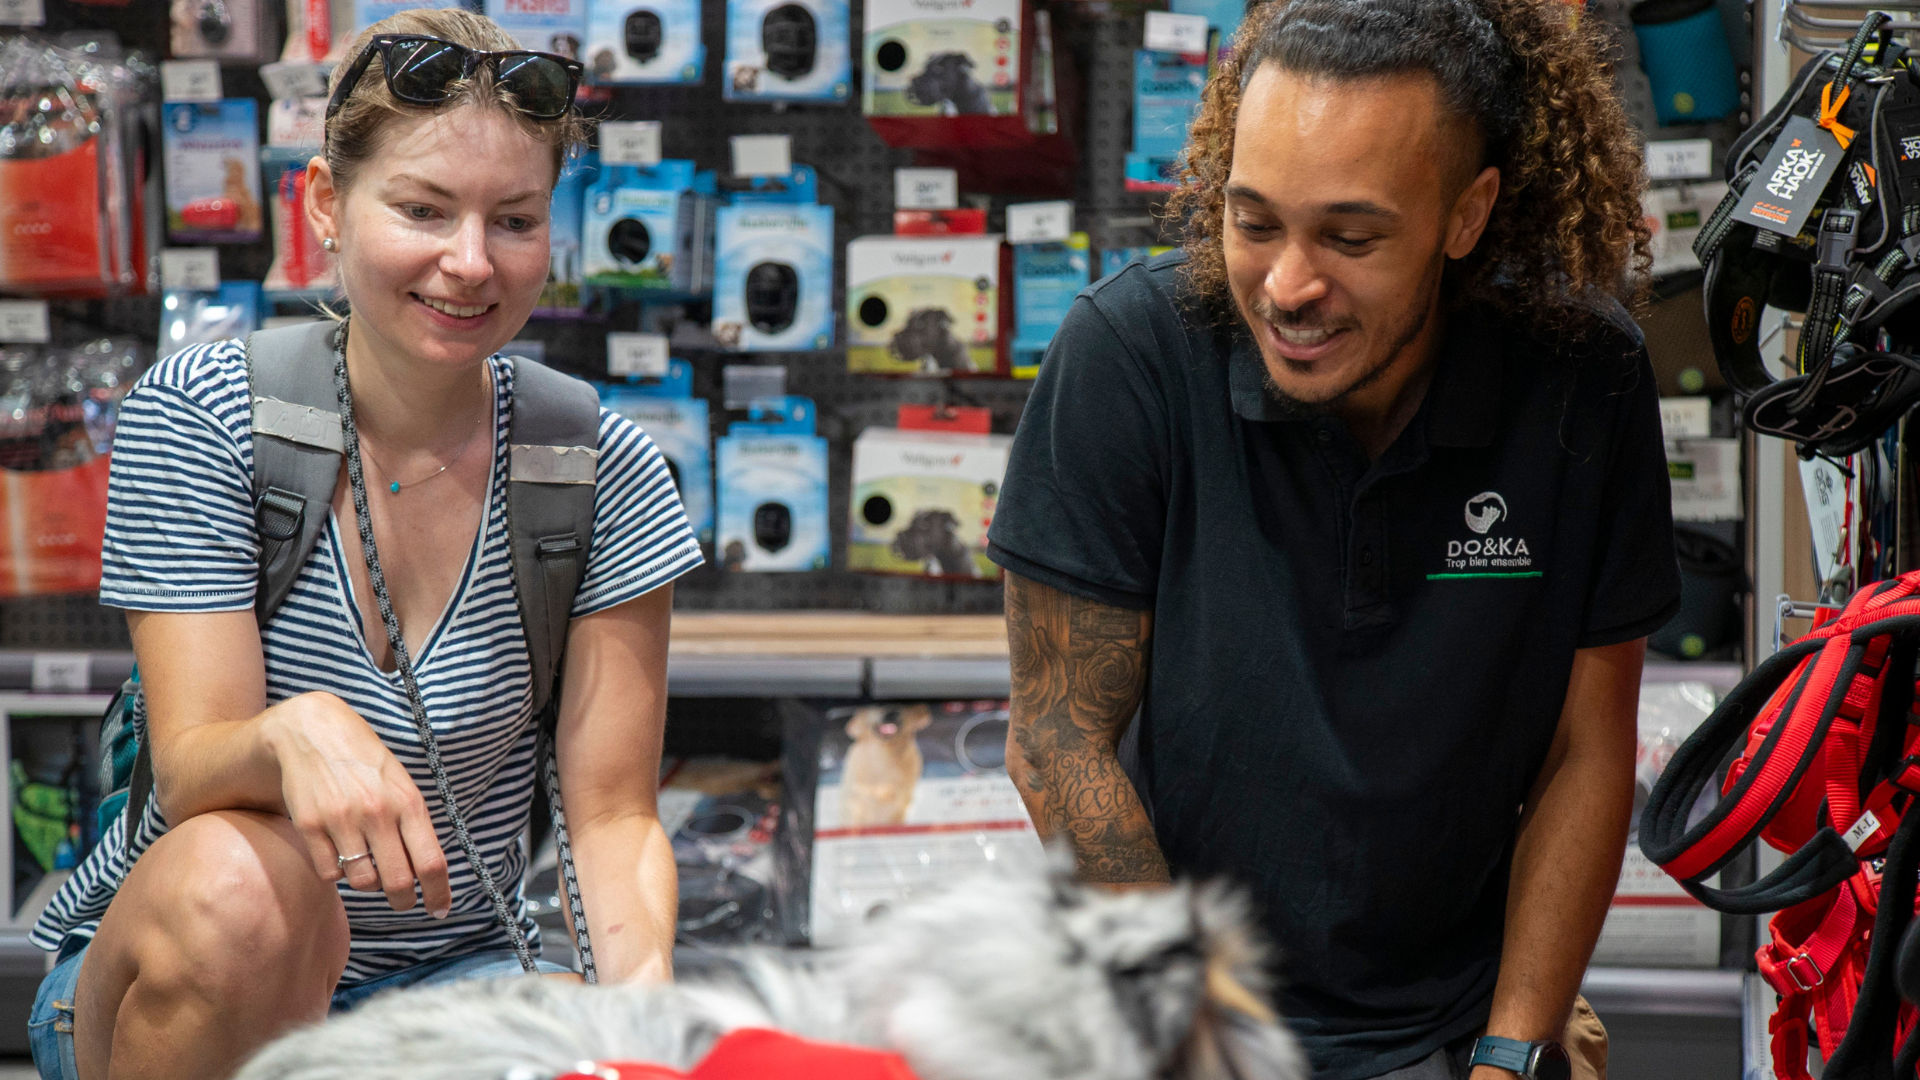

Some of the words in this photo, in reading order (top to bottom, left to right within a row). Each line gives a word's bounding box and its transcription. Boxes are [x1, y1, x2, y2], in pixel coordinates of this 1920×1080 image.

[1766, 148, 1804, 196] ARKA
[1778, 149, 1820, 200] HAOK.
[1850, 165, 1871, 205] ARKA
[1447, 537, 1530, 557] DO&KA
[1445, 558, 1466, 570] Trop
[1469, 556, 1488, 567] bien
[1491, 556, 1531, 567] ensemble
[1852, 817, 1875, 840] M-L
